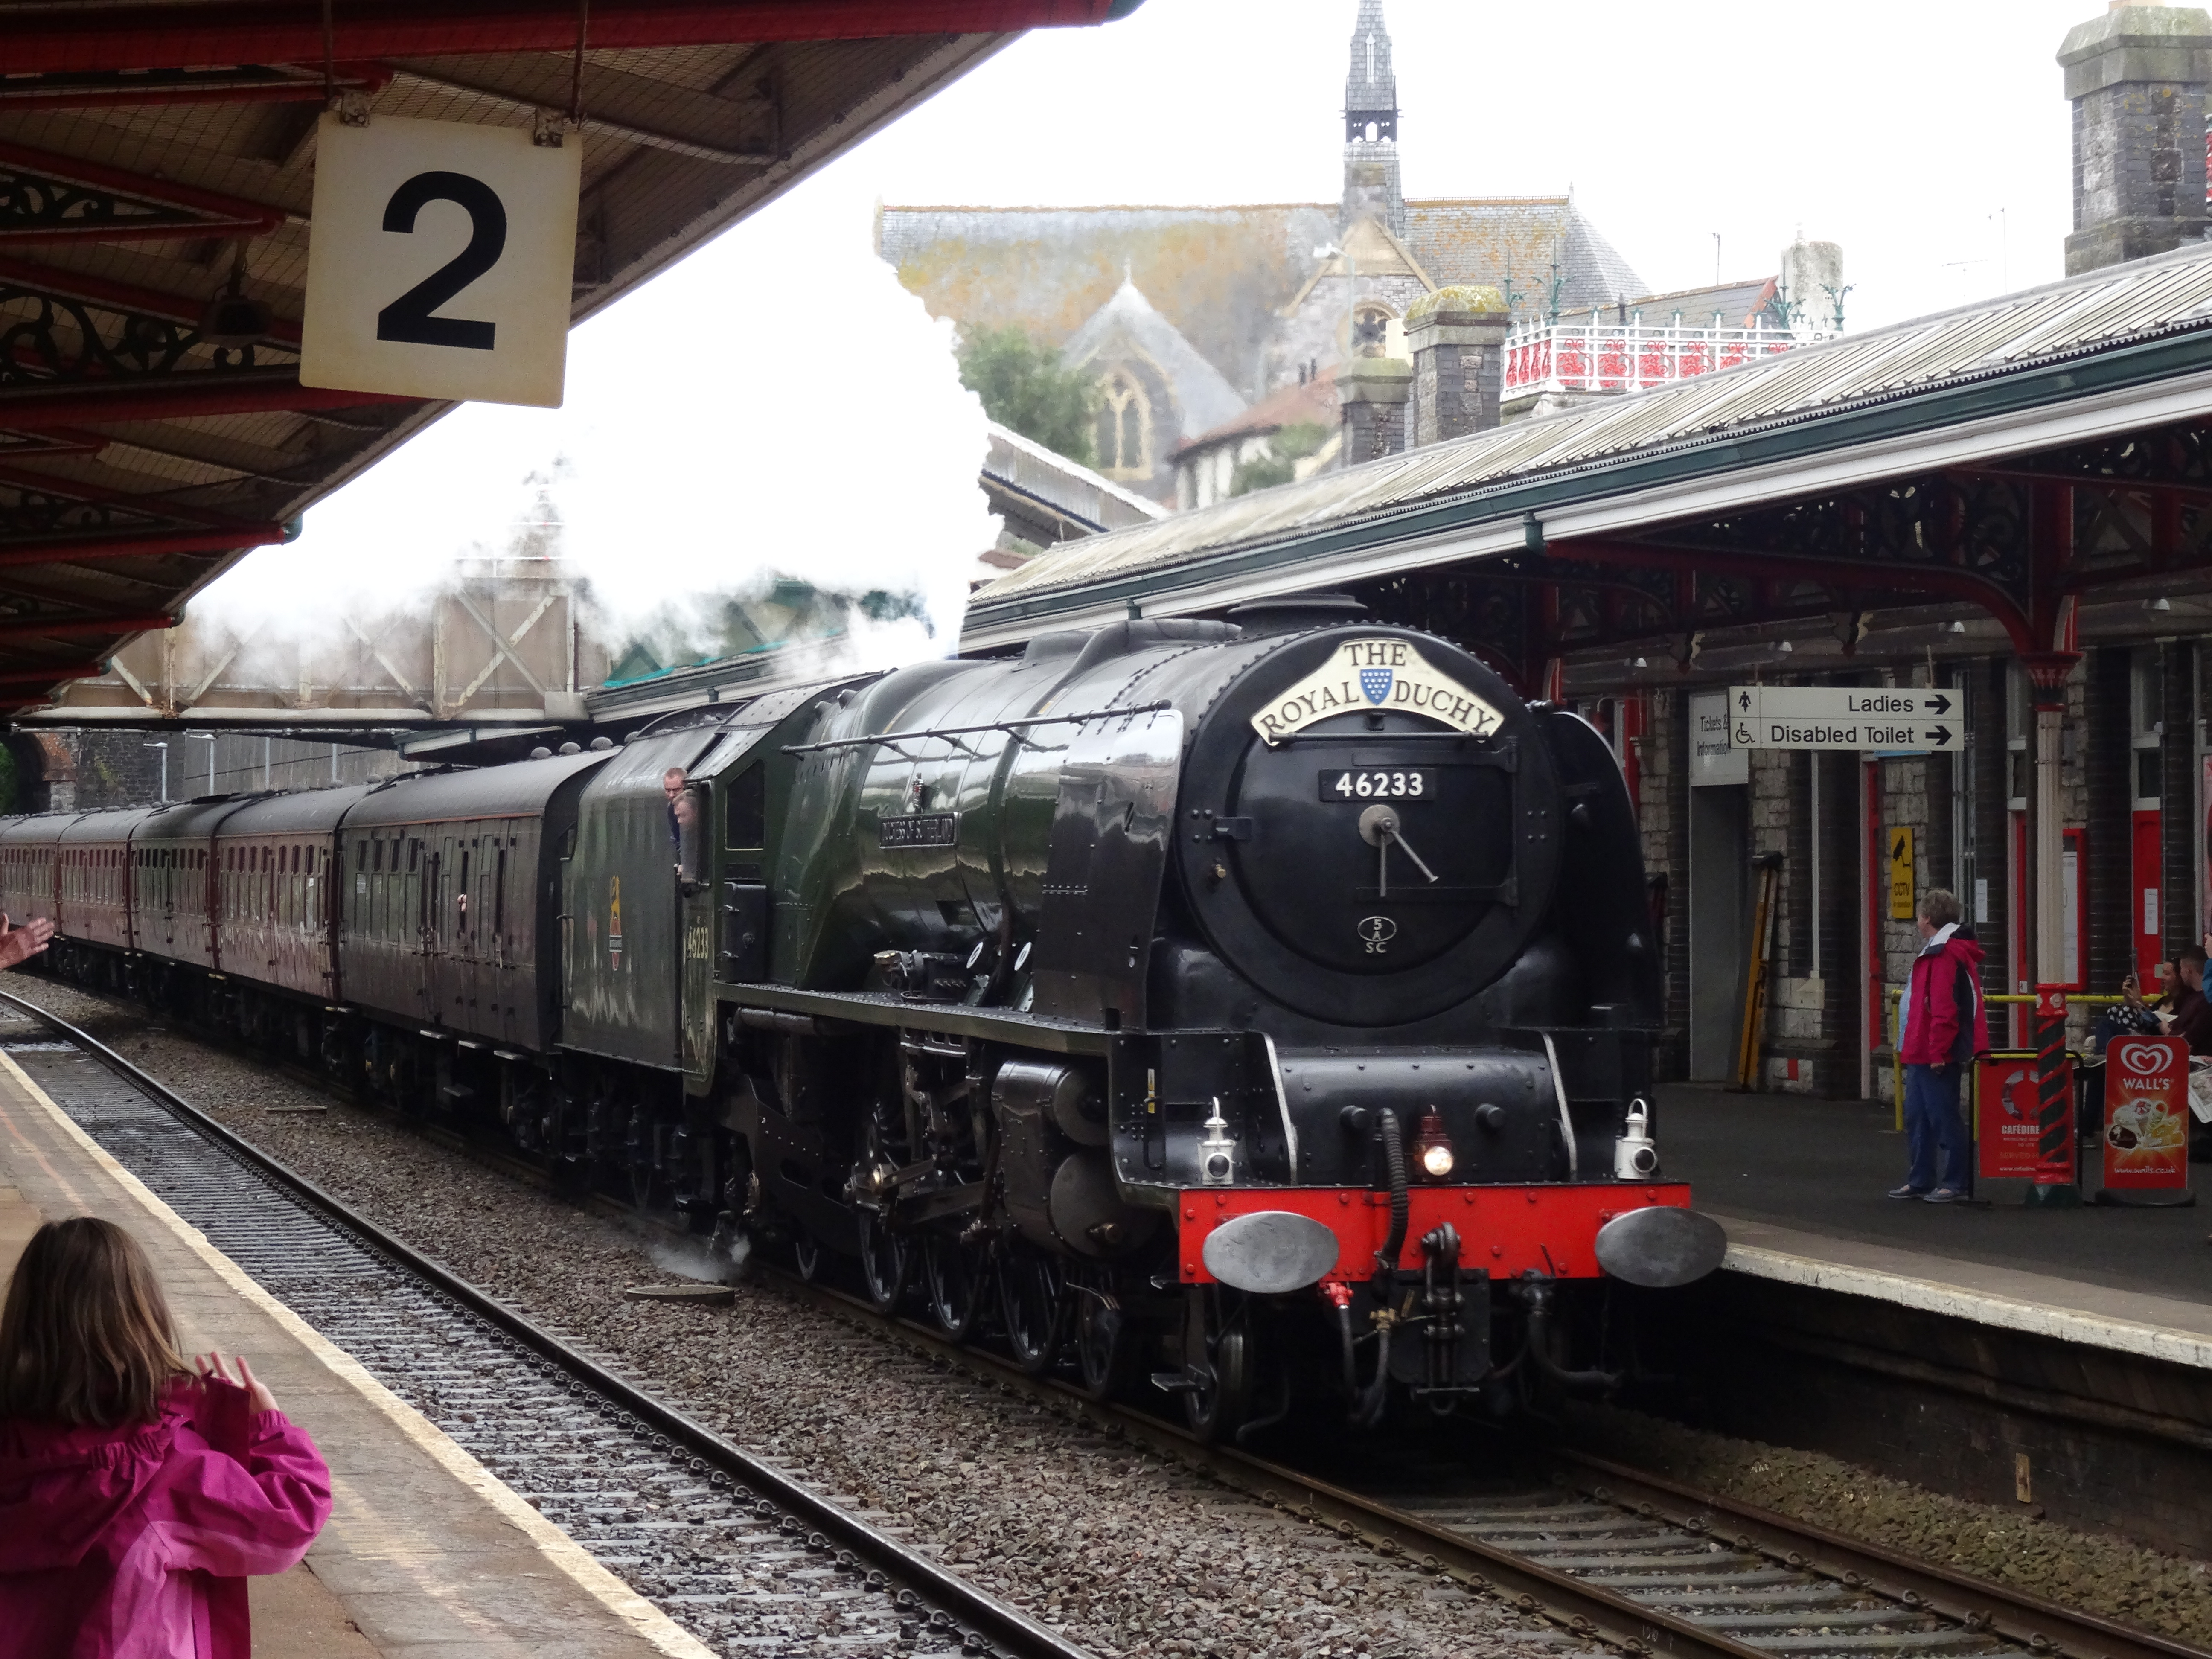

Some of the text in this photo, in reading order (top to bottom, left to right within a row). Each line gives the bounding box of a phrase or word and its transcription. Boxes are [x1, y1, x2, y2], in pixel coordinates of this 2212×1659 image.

[377, 171, 507, 350] 2
[1344, 643, 1407, 667] THE
[1260, 680, 1495, 733] ROYAL DUCHY
[1848, 695, 1914, 713] Ladies
[1700, 716, 1722, 732] Tickets
[1771, 725, 1914, 744] Disabled Toilet
[1335, 773, 1423, 797] 46233
[1374, 918, 1382, 931] 5
[687, 926, 709, 959] 46233
[1365, 941, 1387, 954] SC
[2122, 1077, 2171, 1090] WALL'S
[2001, 1124, 2040, 1135] CAFÉDIRE
